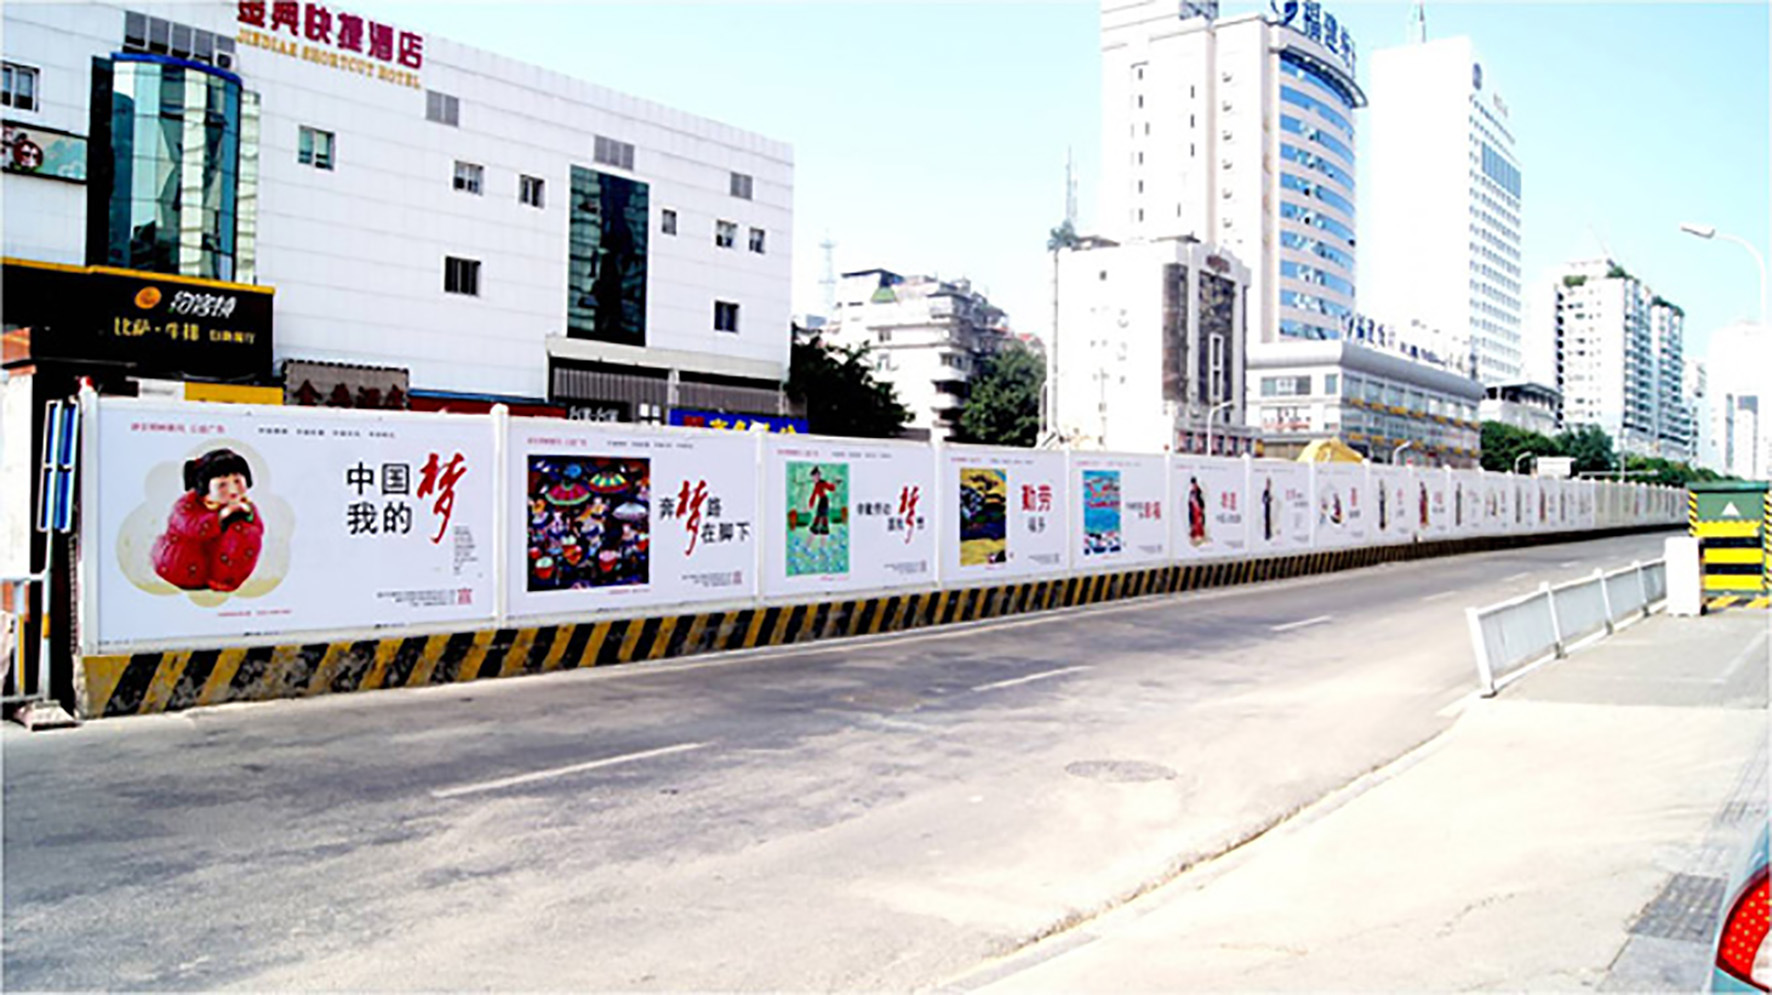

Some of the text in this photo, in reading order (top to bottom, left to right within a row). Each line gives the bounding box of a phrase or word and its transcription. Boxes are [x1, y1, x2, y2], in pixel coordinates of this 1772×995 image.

[236, 28, 421, 89] JINDIAN SHORTCUT HOTEL
[237, 0, 423, 69] 金典快捷酒店
[346, 461, 410, 496] 中国
[416, 452, 467, 544] 梦
[346, 501, 412, 535] 我的
